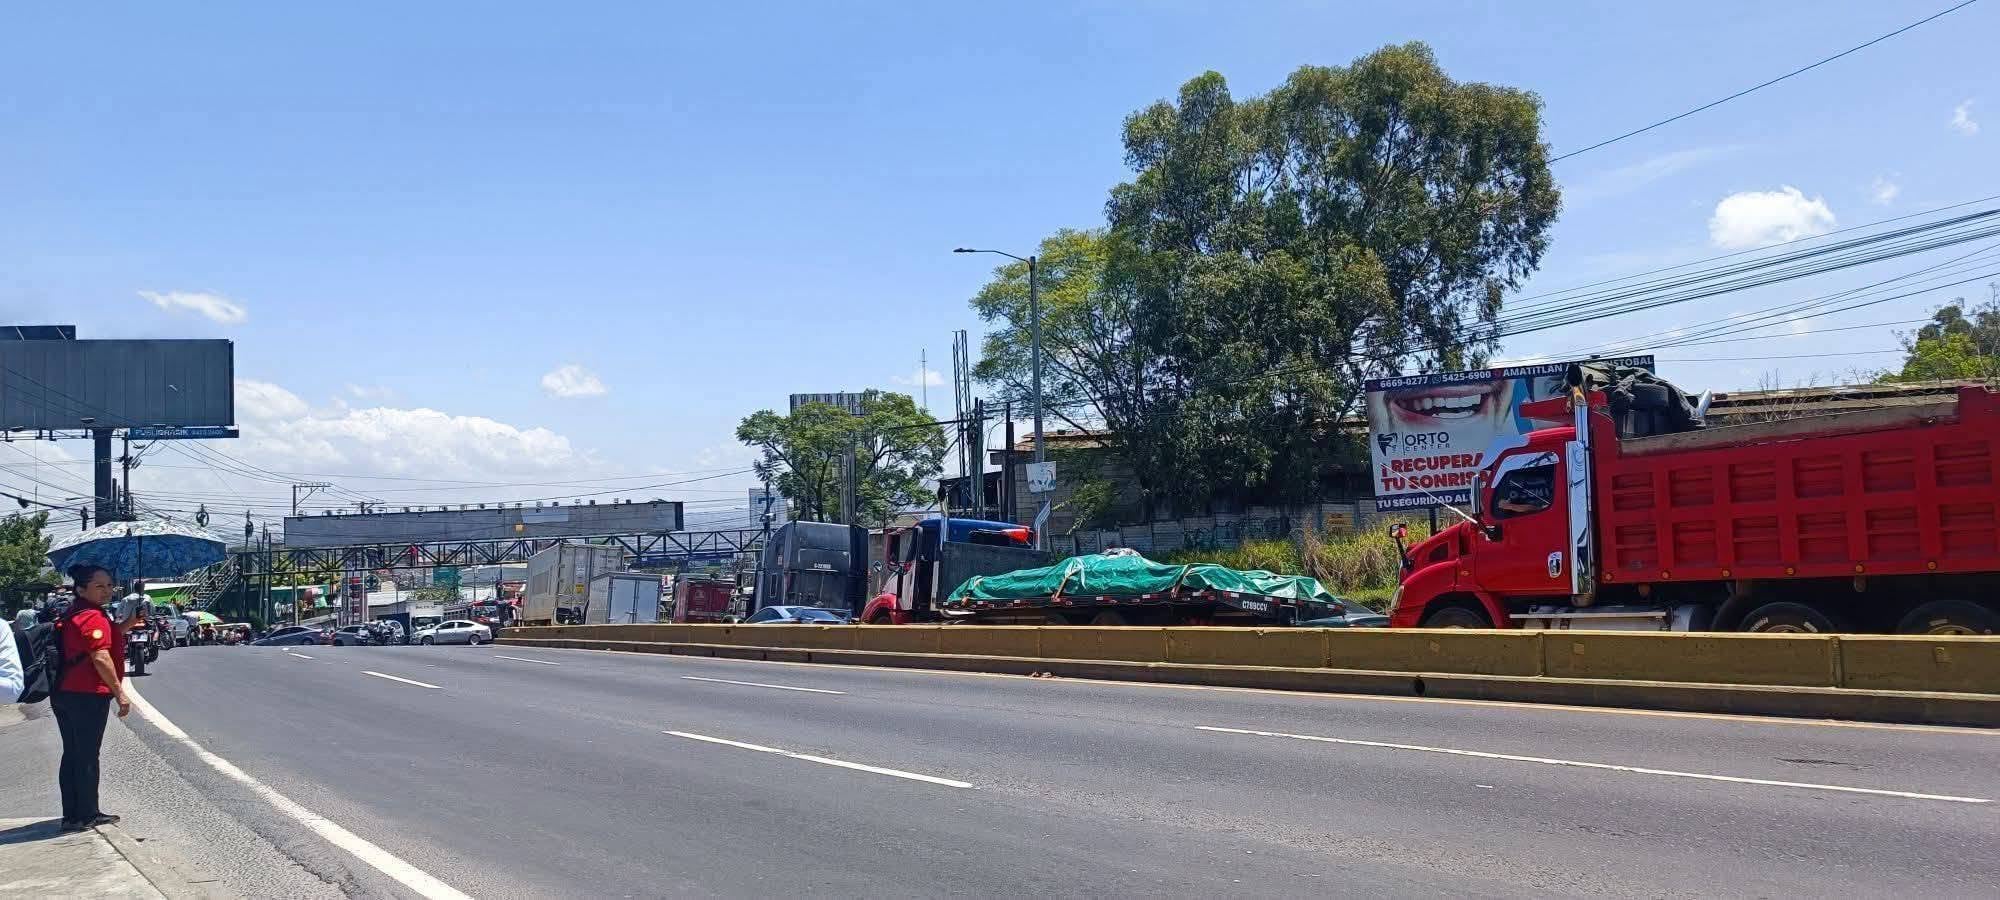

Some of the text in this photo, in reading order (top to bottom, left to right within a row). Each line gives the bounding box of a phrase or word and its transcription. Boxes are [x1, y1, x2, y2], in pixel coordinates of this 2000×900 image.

[1380, 376, 1428, 388] 6669-0277
[1442, 370, 1491, 383] 5425-6900
[1503, 364, 1563, 377] AMATITLAN
[1405, 432, 1449, 447] ORTO
[1405, 443, 1450, 452] CENTER
[1381, 477, 1406, 491] TU
[1377, 493, 1468, 508] TU SEGURIDAD AL
